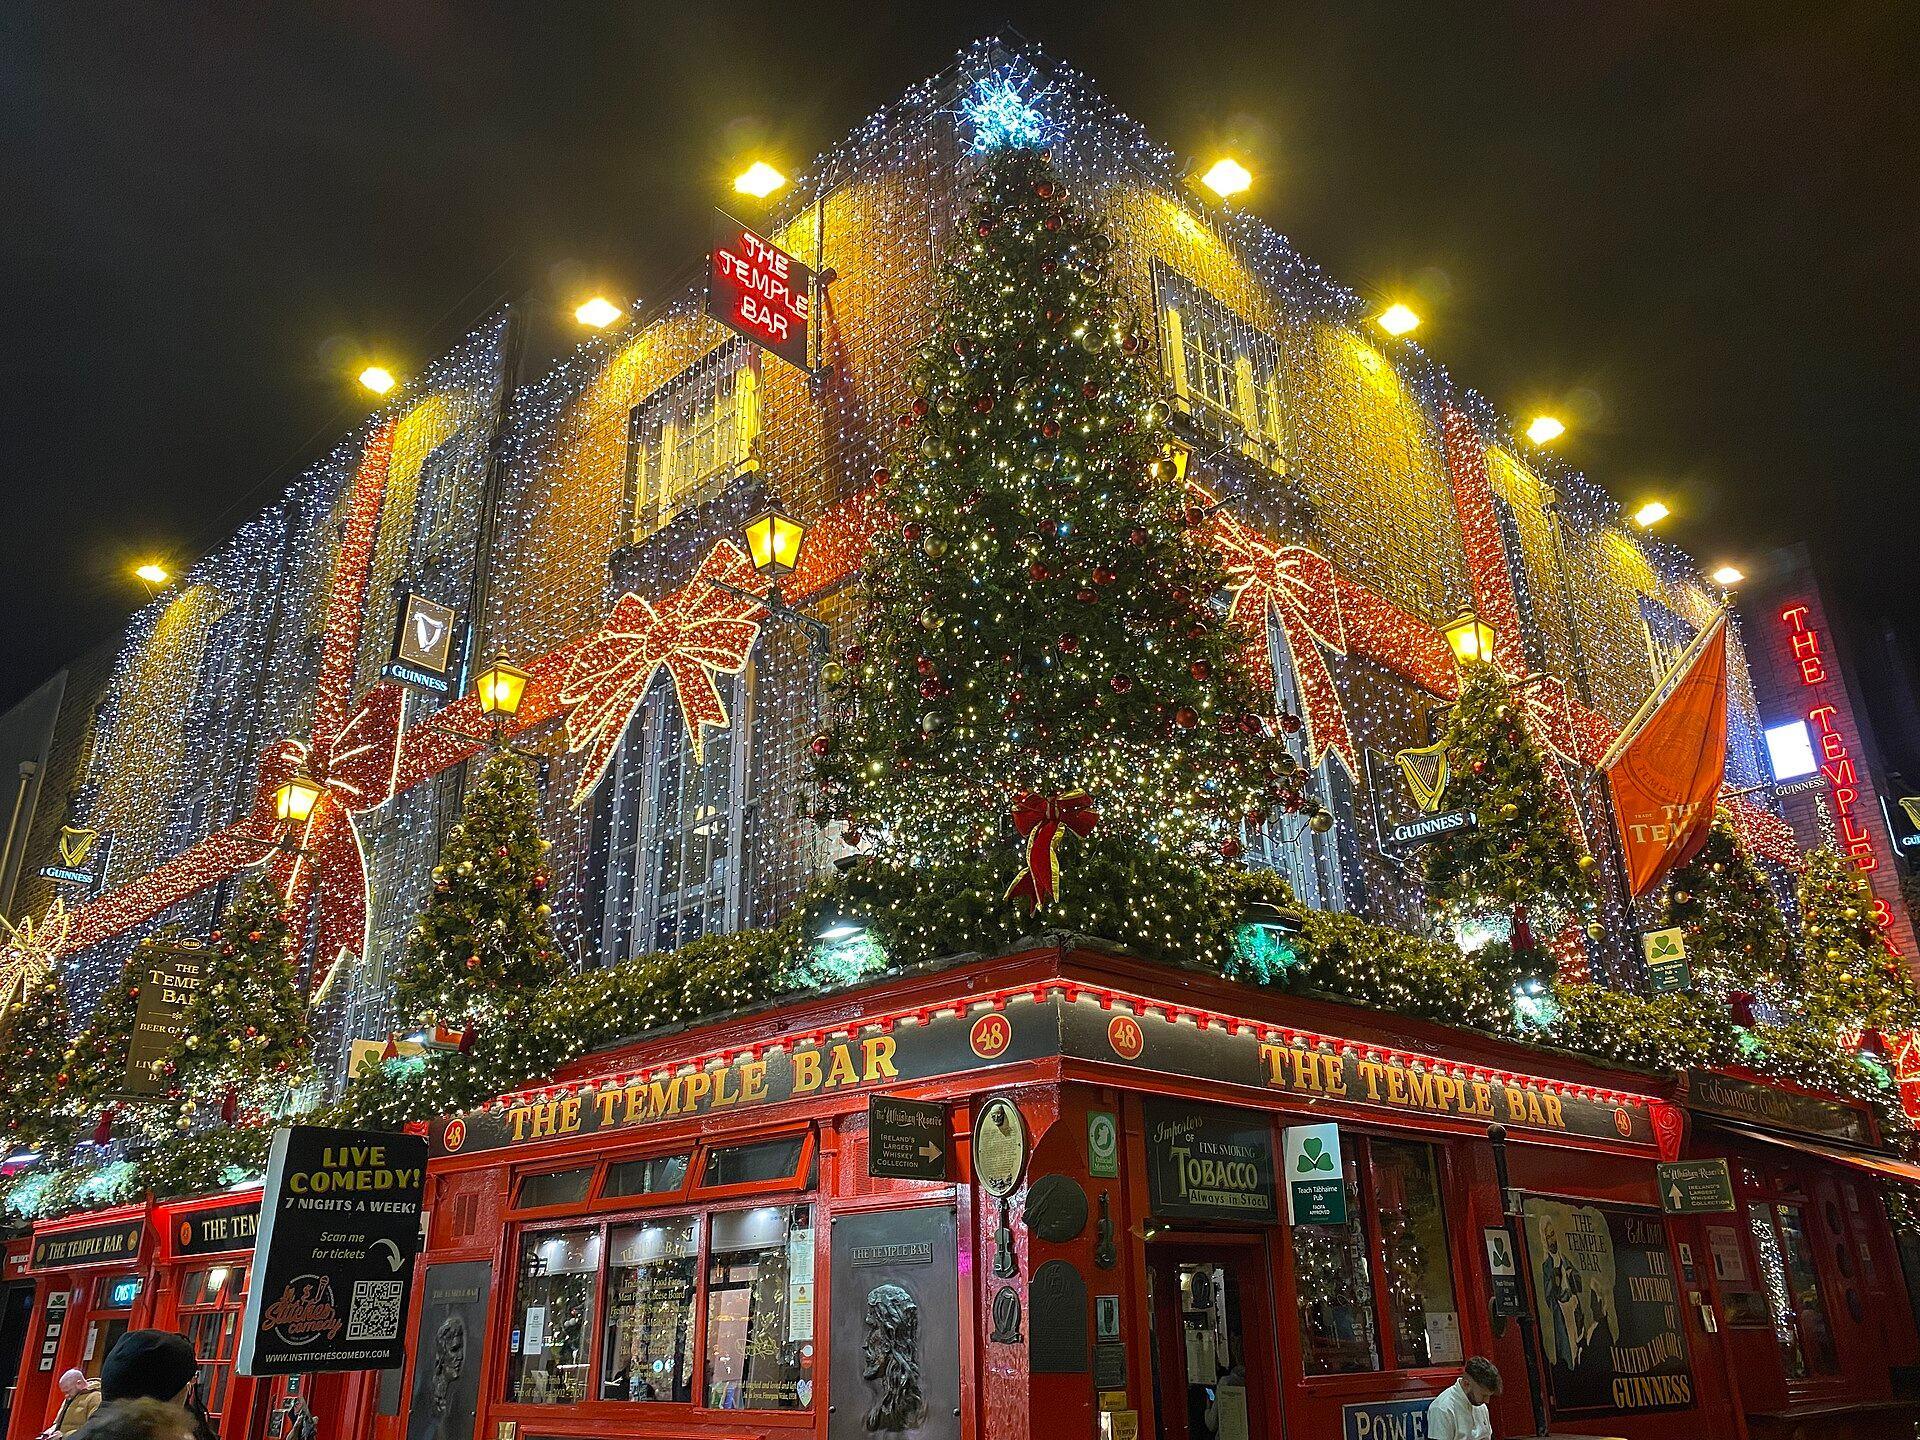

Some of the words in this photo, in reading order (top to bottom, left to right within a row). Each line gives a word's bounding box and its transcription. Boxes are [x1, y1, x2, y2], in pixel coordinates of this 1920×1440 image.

[743, 232, 789, 280] THE
[719, 250, 809, 320] TEMPLE
[741, 296, 788, 339] BAR
[392, 664, 448, 692] GUINNESS
[1782, 606, 1826, 684] THE
[1808, 705, 1880, 871] TEMPLE
[1776, 777, 1825, 796] GUINNESS
[1395, 812, 1464, 841] GUINNESS
[46, 867, 94, 884] GUINNESS
[175, 963, 200, 974] THE
[140, 1023, 166, 1033] BEER
[976, 1022, 1003, 1051] 48
[1114, 1021, 1137, 1049] 48
[508, 1097, 582, 1142] THE
[597, 1060, 769, 1125] TEMPLE
[793, 1035, 899, 1093] BAR
[1260, 1043, 1347, 1095] THE
[1357, 1060, 1495, 1117] TEMPLE
[1504, 1086, 1566, 1128] BAR
[884, 1106, 915, 1127] Whiskey
[916, 1111, 943, 1129] Reserve
[1618, 1112, 1628, 1131] 48
[447, 1126, 461, 1147] 48
[880, 1133, 915, 1143] IRELAND'S
[1153, 1115, 1203, 1145] Importers
[1185, 1133, 1195, 1143] OF
[322, 1146, 386, 1169] LIVE
[882, 1151, 914, 1159] WHISKEY
[883, 1143, 913, 1151] LARGEST
[1199, 1141, 1218, 1155] FINE
[1219, 1144, 1256, 1158] SMOKING
[876, 1159, 919, 1168] COLLECTION
[1169, 1146, 1258, 1197] TOBACCO
[290, 1168, 421, 1194] COMEDY!
[1297, 1186, 1312, 1194] Teach
[285, 1197, 295, 1209] 7
[298, 1198, 352, 1211] NIGHTS
[355, 1200, 365, 1212] A
[370, 1201, 416, 1214] WEEK!
[1190, 1190, 1225, 1204] Always
[1229, 1194, 1238, 1204] in
[1240, 1194, 1267, 1207] Stock
[201, 1218, 228, 1241] THE
[1572, 1214, 1595, 1233] THE
[48, 1242, 67, 1260] THE
[67, 1238, 102, 1257] TEMPLE
[104, 1233, 123, 1251] BAR
[320, 1232, 347, 1243] Scan
[349, 1234, 365, 1243] me
[1565, 1232, 1607, 1253] TEMPLE
[311, 1248, 328, 1260] for
[330, 1248, 365, 1259] tickets
[665, 1241, 686, 1259] BAR
[853, 1249, 869, 1259] THE
[872, 1246, 908, 1258] TEMPLE
[910, 1243, 930, 1255] BAR
[1579, 1252, 1602, 1272] BAR
[1646, 1251, 1668, 1276] THE
[1629, 1277, 1674, 1303] EMPEROR
[1664, 1305, 1676, 1330] OF
[265, 1350, 390, 1363] WWW.INSTITCHESCOMEDY.COM
[1610, 1345, 1651, 1374] MALTED
[1649, 1333, 1683, 1369] LIQUORS
[1612, 1375, 1691, 1409] GUINNESS
[1354, 1410, 1428, 1440] POWE
